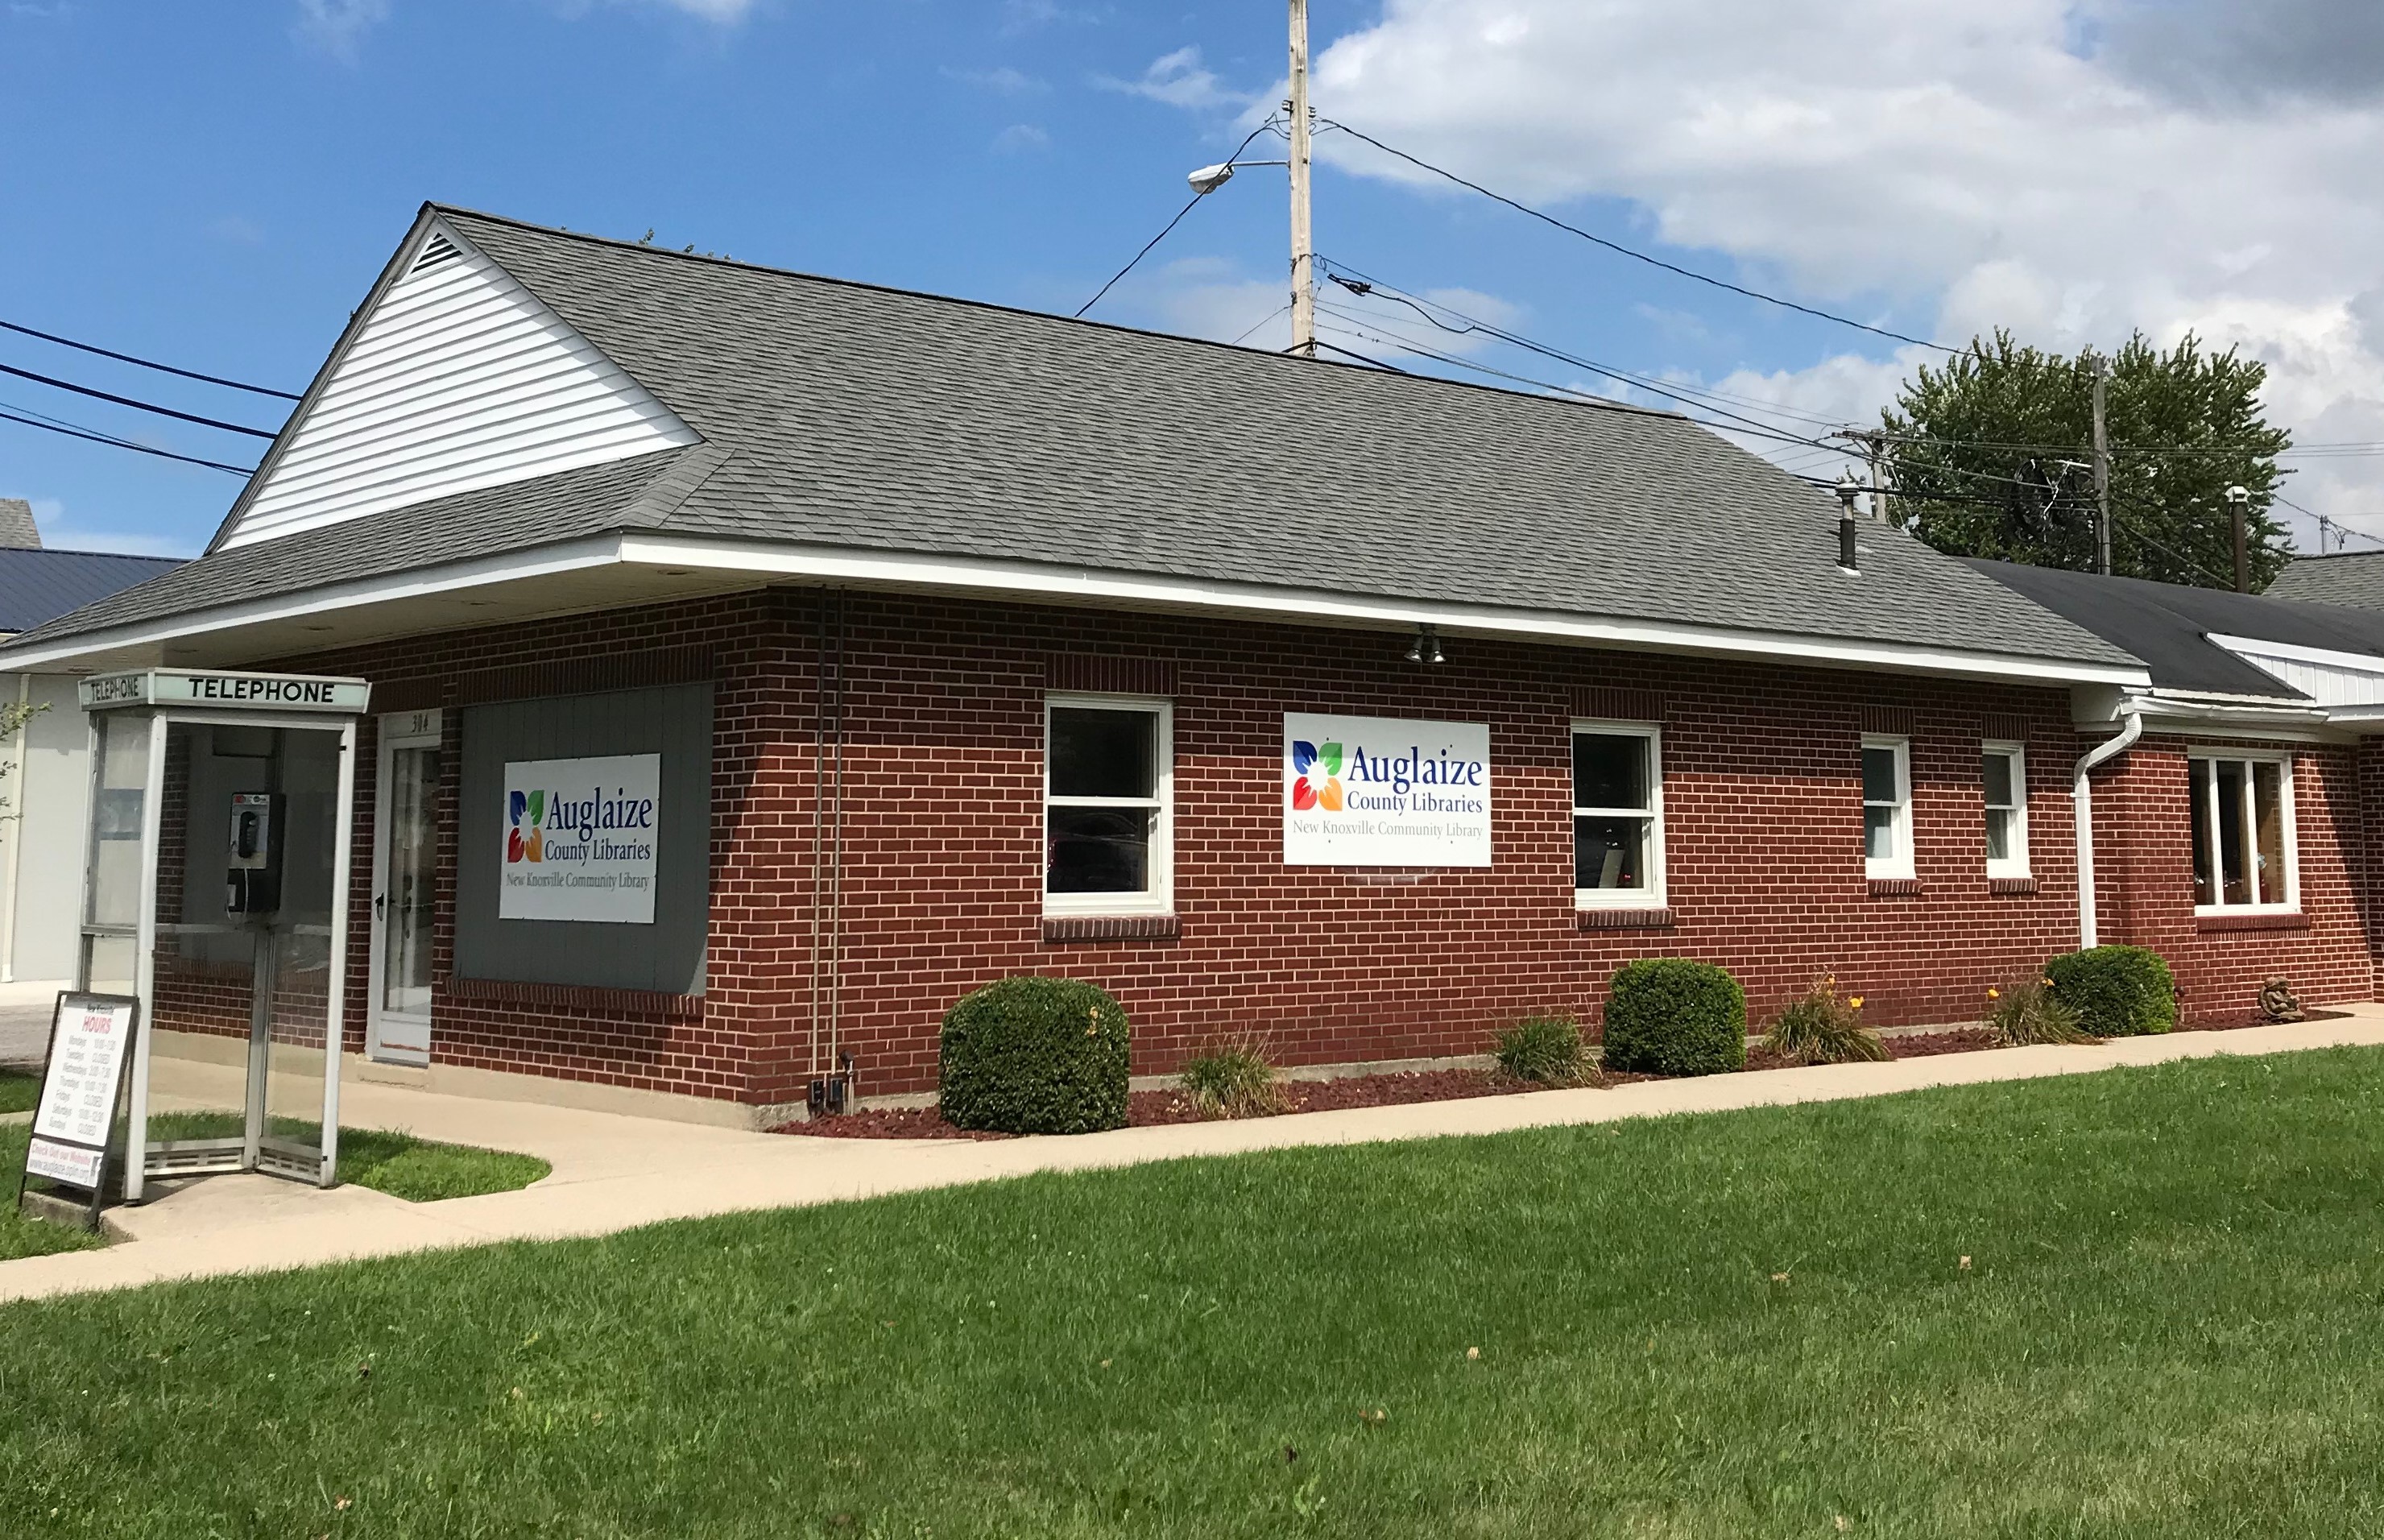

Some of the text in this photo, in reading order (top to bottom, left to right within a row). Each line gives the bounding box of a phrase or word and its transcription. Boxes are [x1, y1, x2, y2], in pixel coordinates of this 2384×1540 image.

[91, 677, 139, 702] TELEPHONE
[188, 677, 335, 703] TELEPHONE
[412, 714, 428, 732] 304
[1347, 745, 1483, 794] Auglaize
[545, 786, 652, 842] Auglaize
[1347, 790, 1483, 816] County Libraries
[1293, 819, 1483, 840] New Knoxville Community Library
[545, 838, 651, 867] County Libraries
[507, 871, 650, 892] New Knoxville Community Library
[81, 1016, 112, 1034] HOURS
